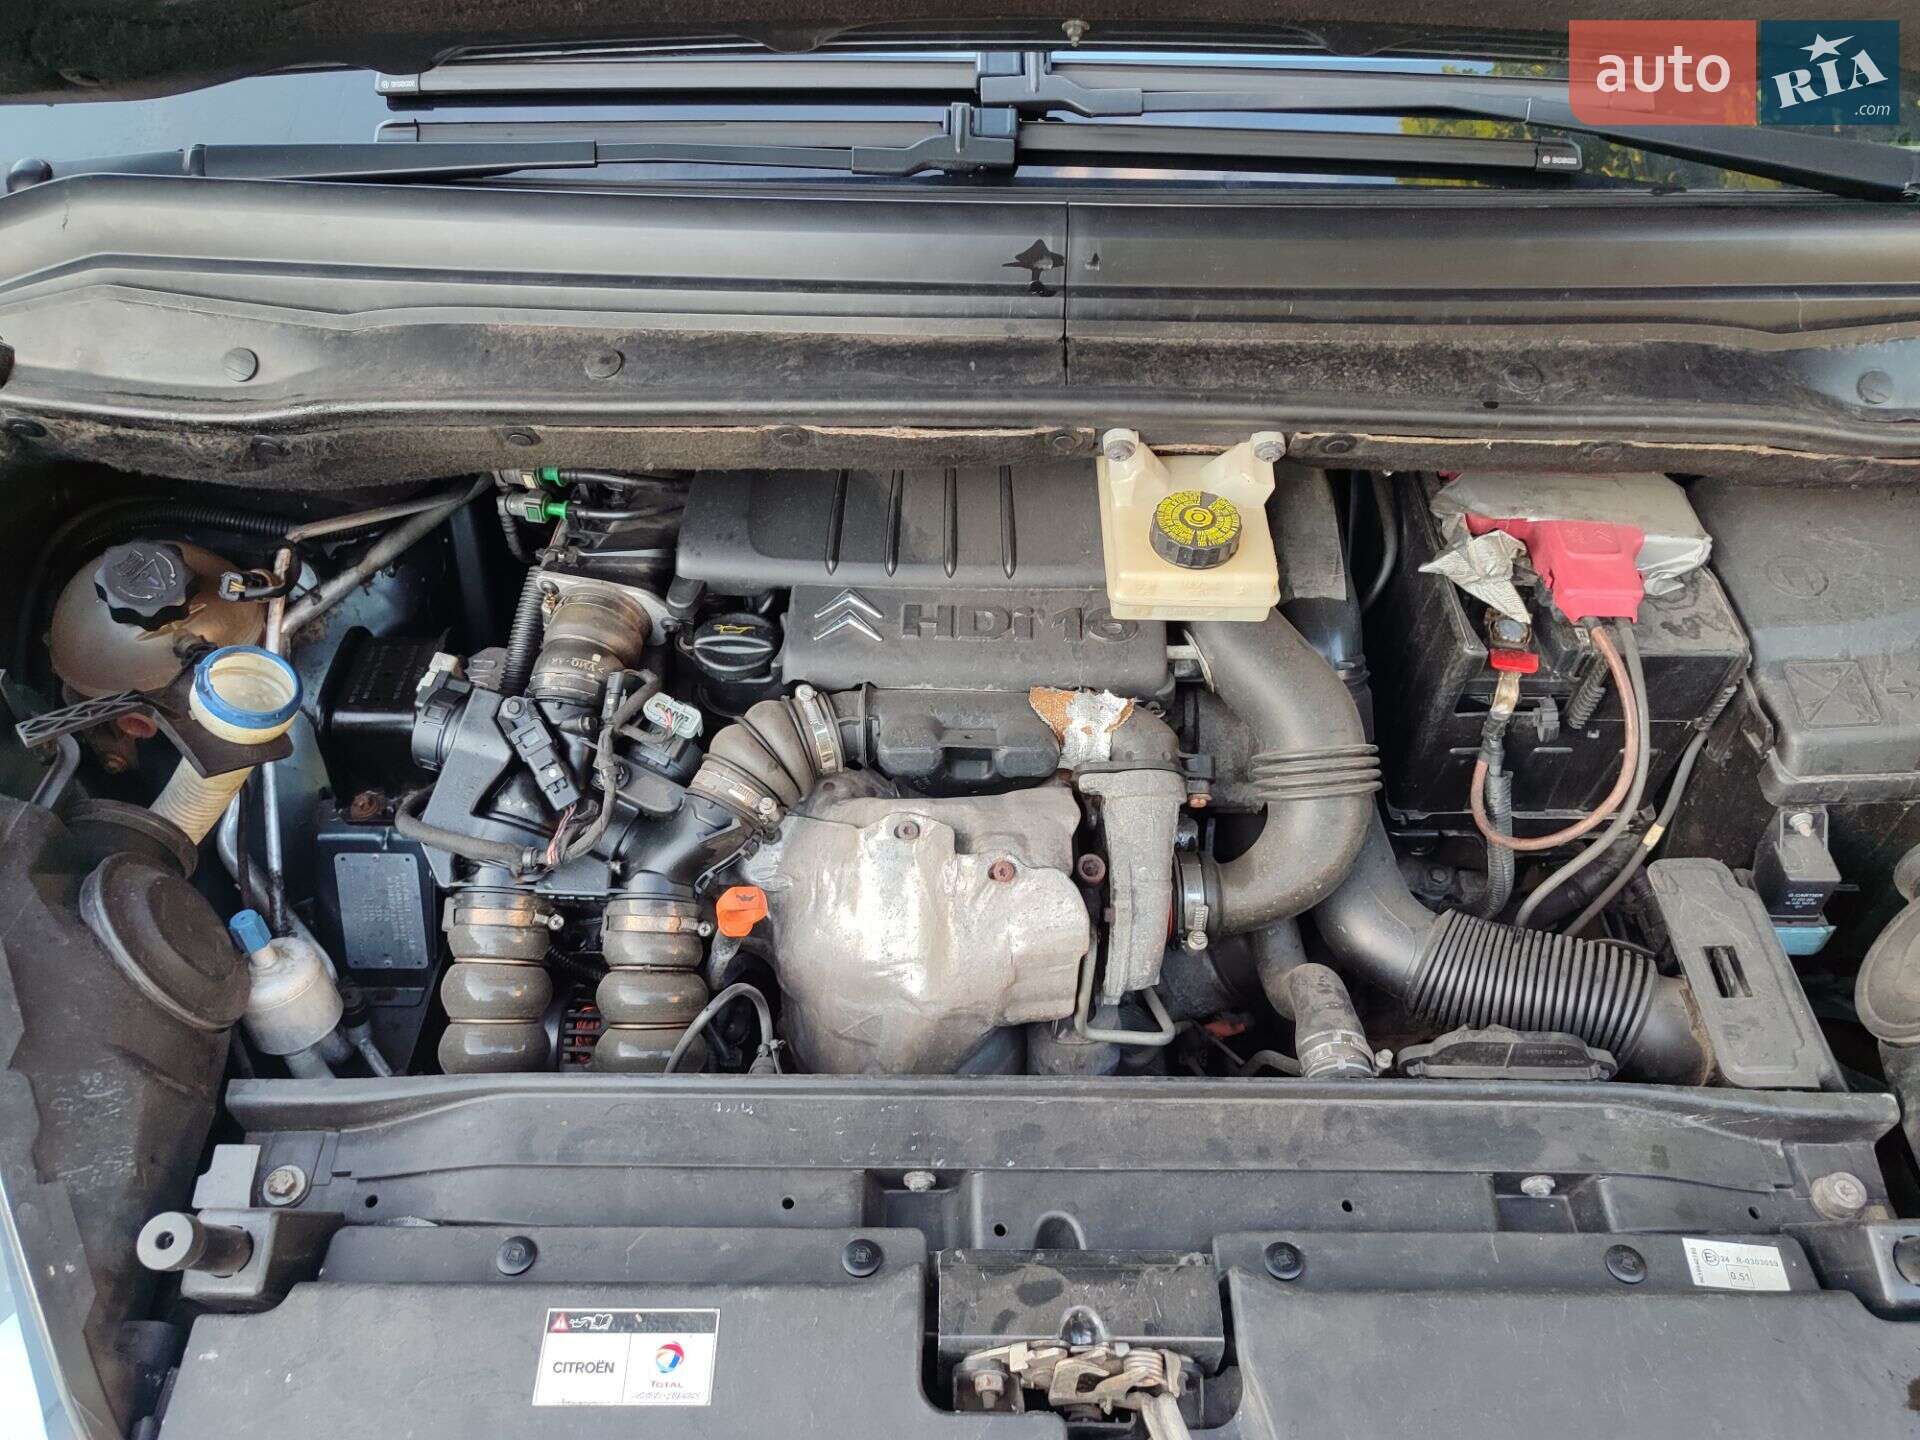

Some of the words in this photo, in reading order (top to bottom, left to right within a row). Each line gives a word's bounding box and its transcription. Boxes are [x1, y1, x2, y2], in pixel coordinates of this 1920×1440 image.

[902, 604, 1034, 642] HDi
[552, 1360, 615, 1374] CITROËN
[649, 1380, 685, 1389] TOTAL
